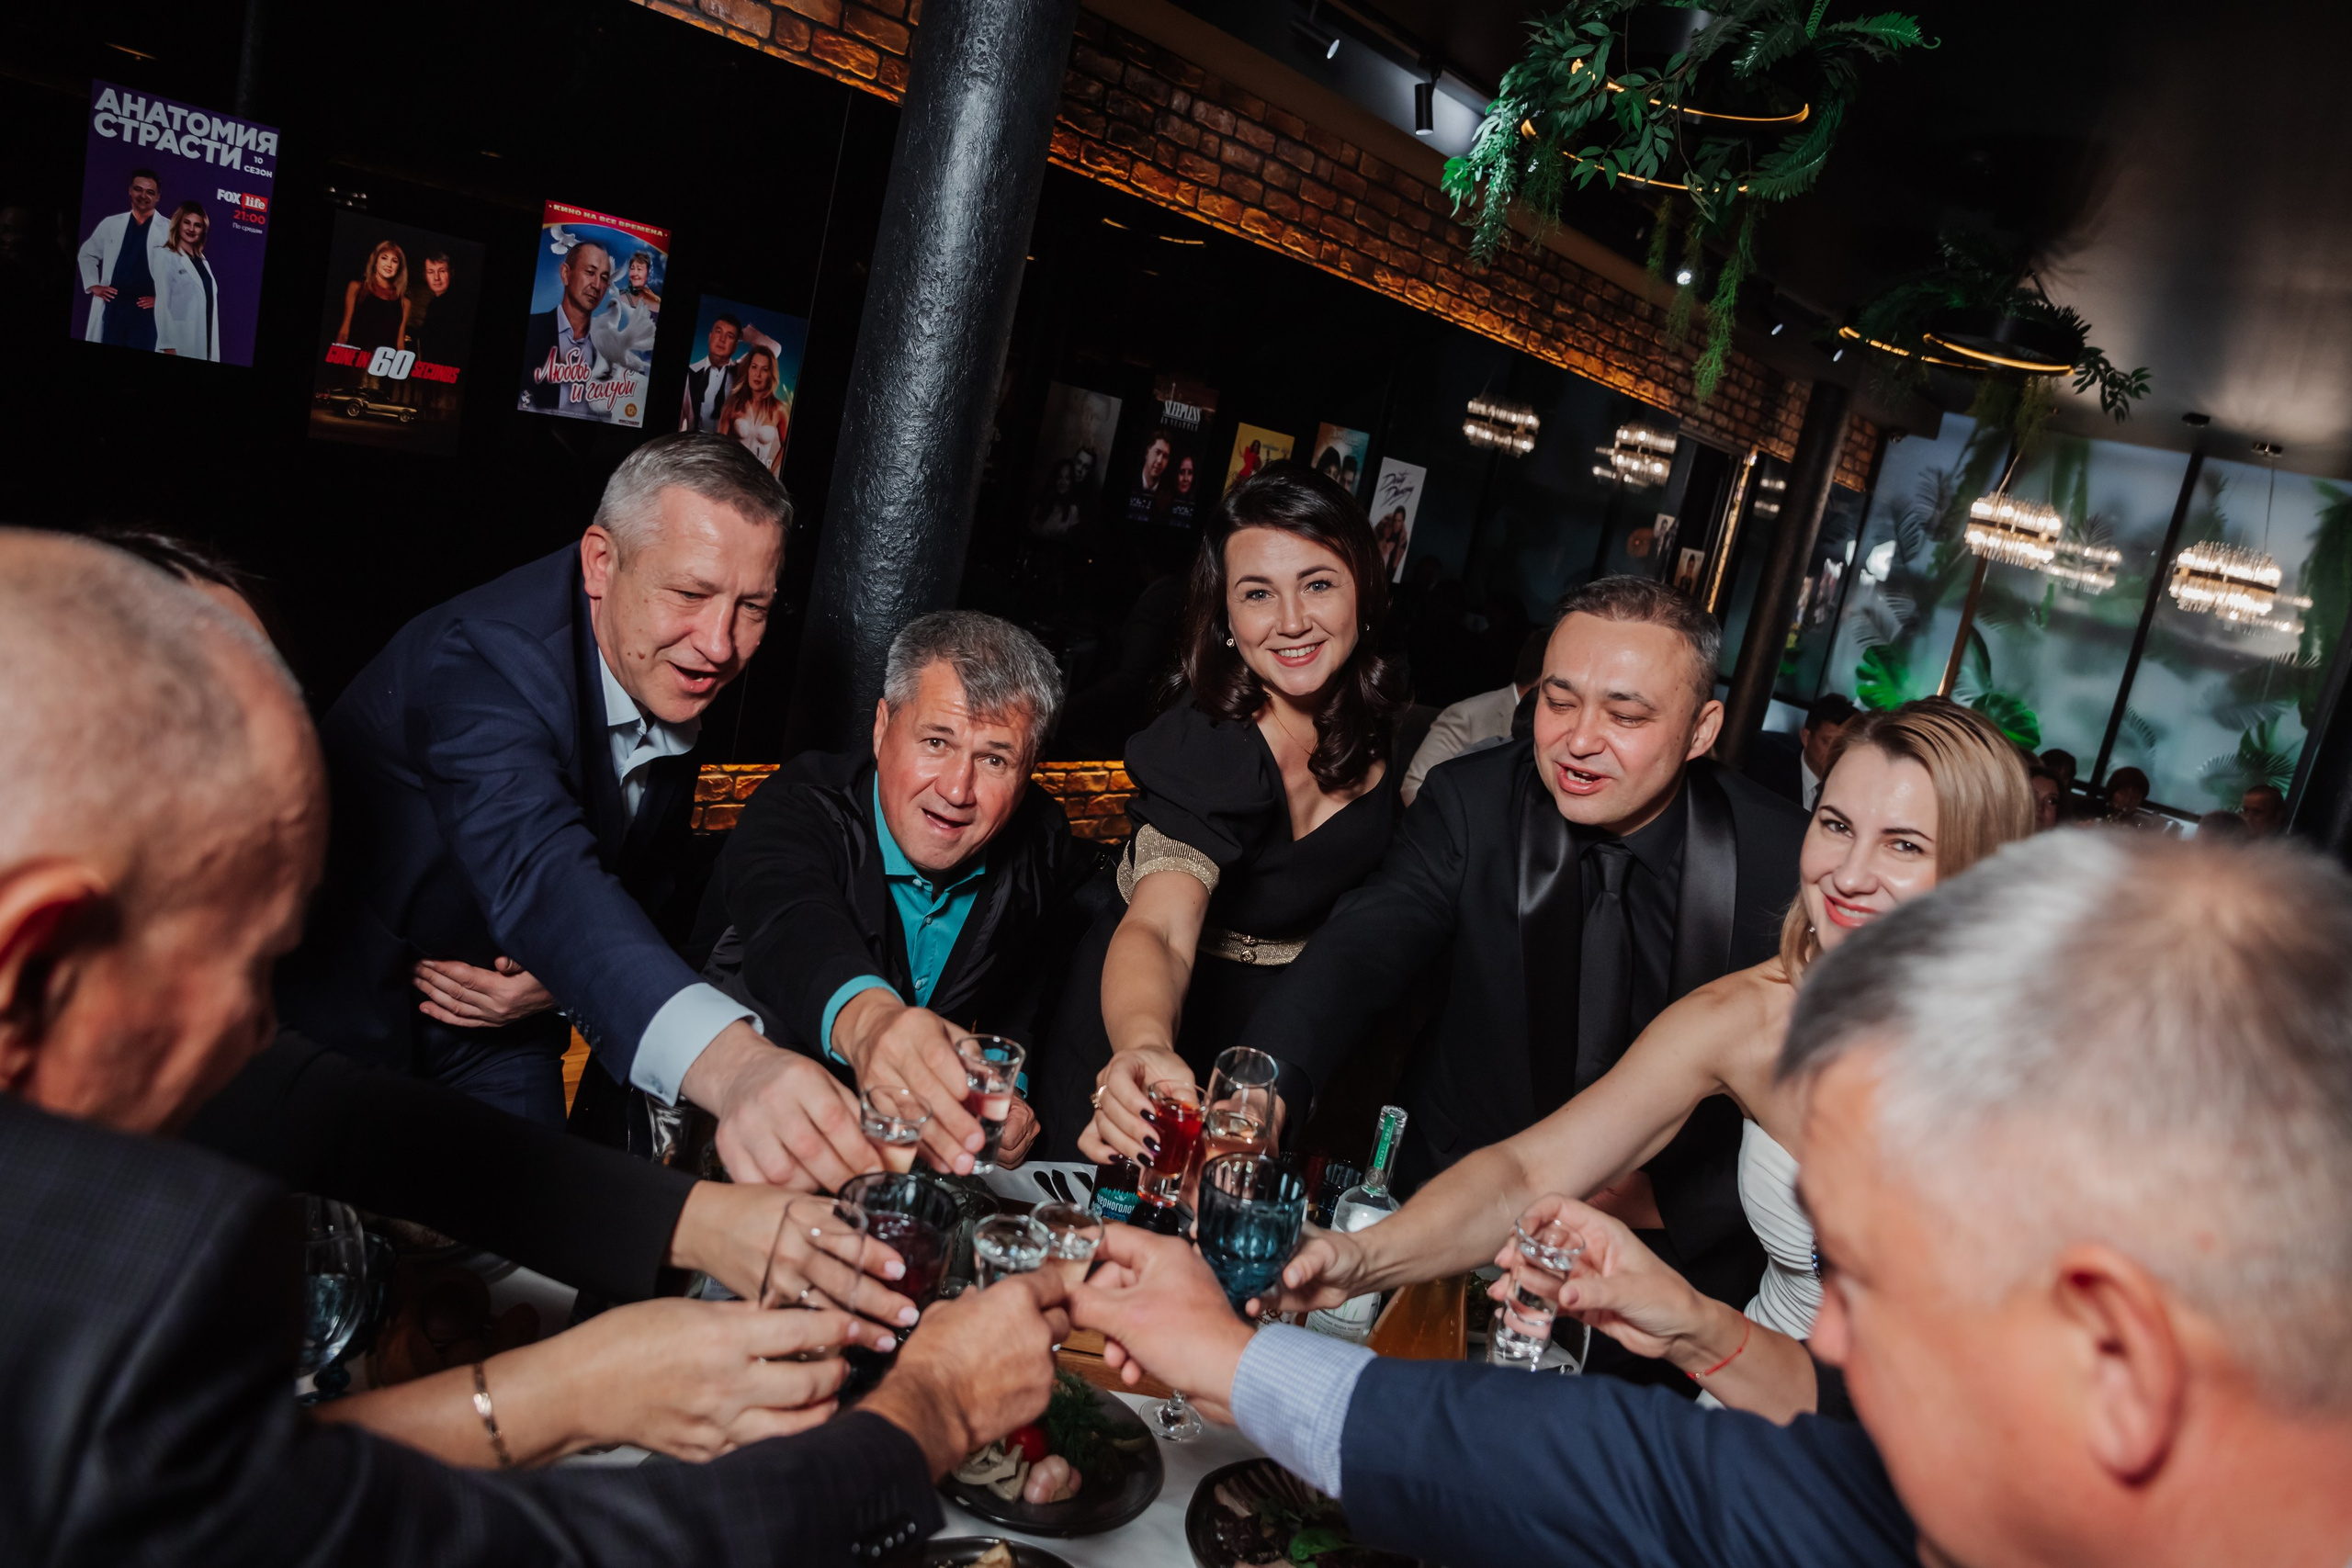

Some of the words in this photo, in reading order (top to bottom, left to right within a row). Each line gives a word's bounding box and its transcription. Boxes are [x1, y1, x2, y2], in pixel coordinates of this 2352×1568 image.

[95, 87, 278, 156] АНАТОМИЯ
[94, 112, 242, 171] СТРАСТИ
[243, 164, 273, 178] СЕЗОН
[254, 156, 264, 164] 10
[217, 188, 242, 205] FOX
[244, 195, 266, 209] life
[232, 222, 241, 231] По
[233, 209, 266, 225] 21:00
[553, 203, 582, 217] КИНО
[583, 210, 597, 220] НА
[599, 215, 617, 226] ВСЕ
[618, 219, 663, 237] ВРЕМЕНА
[325, 344, 357, 367] GONE
[368, 345, 416, 380] 60
[411, 360, 460, 384] SECONDS
[534, 345, 591, 385] Любовь
[571, 382, 582, 402] и
[585, 369, 638, 411] голуби
